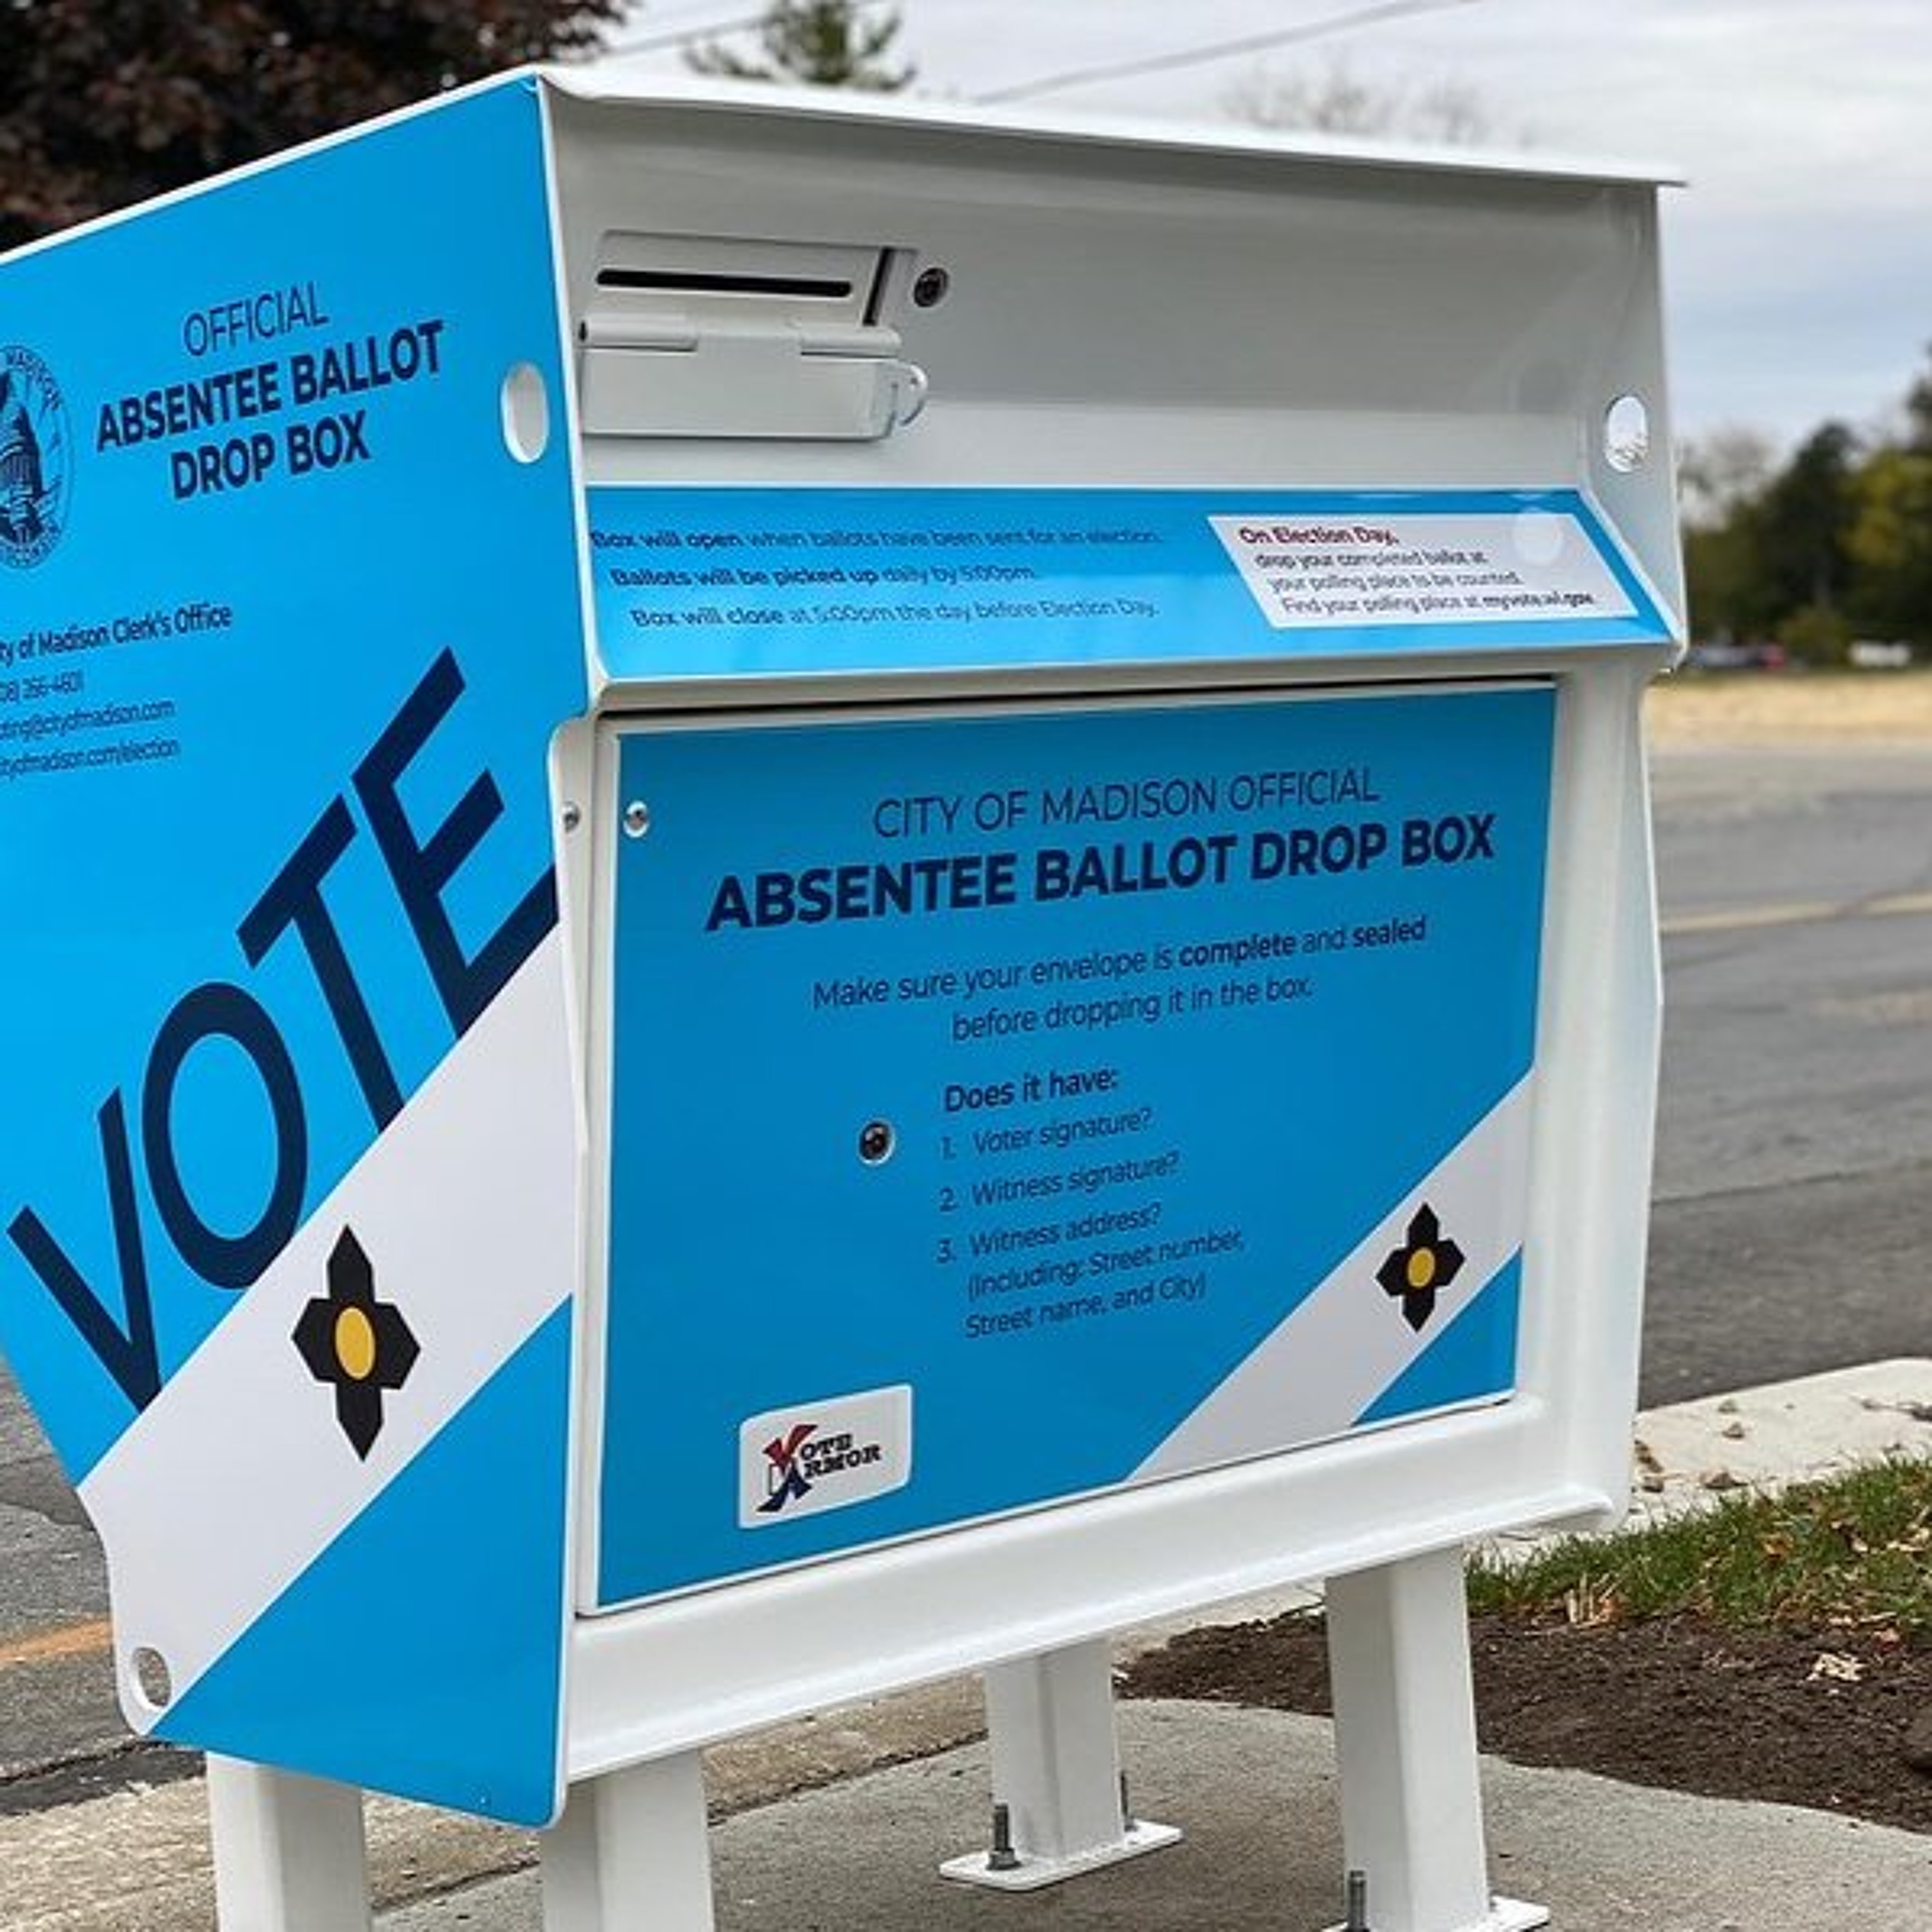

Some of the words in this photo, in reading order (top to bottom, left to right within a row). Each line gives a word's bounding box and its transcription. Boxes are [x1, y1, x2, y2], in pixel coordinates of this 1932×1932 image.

[184, 283, 328, 356] OFFICIAL
[97, 364, 281, 451] ABSENTEE
[292, 321, 443, 404] BALLOT
[171, 433, 275, 498] DROP
[288, 411, 372, 474] BOX
[590, 530, 634, 548] Box
[639, 530, 681, 547] will
[687, 533, 742, 550] open
[931, 530, 983, 545] been
[1239, 527, 1273, 544] On
[1273, 526, 1353, 544] Election
[1296, 554, 1333, 569] your
[1336, 551, 1421, 567] completed
[611, 568, 692, 586] Ballots
[694, 568, 734, 586] will
[736, 568, 768, 585] be
[773, 567, 844, 587] picked
[848, 569, 878, 587] up
[882, 565, 928, 585] daily
[931, 565, 958, 585] by
[1267, 577, 1307, 593] your
[1311, 574, 1366, 591] polling
[1367, 574, 1411, 589] place
[1282, 596, 1321, 612] Find
[1321, 599, 1359, 615] your
[1362, 596, 1419, 613] polling
[1420, 595, 1462, 611] place
[19, 633, 33, 659] of
[39, 624, 110, 656] Madison
[113, 611, 172, 643] Clerk's
[175, 602, 232, 634] Office
[630, 609, 677, 627] Box
[682, 607, 723, 625] will
[726, 607, 784, 625] close
[790, 609, 812, 624] at
[896, 605, 932, 621] the
[936, 603, 971, 623] day
[974, 601, 1036, 619] before
[1039, 600, 1119, 617] Election
[873, 797, 961, 837] CITY
[975, 791, 1028, 831] OF
[1041, 779, 1215, 825] MADISON
[1229, 768, 1379, 811] OFFICIAL
[705, 853, 1017, 931] ABSENTEE
[1036, 833, 1237, 901] BALLOT
[1251, 822, 1387, 880] DROP
[1402, 813, 1496, 867] BOX
[813, 978, 890, 1010] Make
[898, 971, 956, 1000] sure
[963, 964, 1024, 999] your
[1031, 950, 1146, 985] envelope
[1155, 943, 1171, 969] is
[1179, 931, 1296, 969] complete
[1303, 925, 1345, 954] and
[1352, 916, 1426, 947] sealed
[6, 647, 559, 1413] VOTE
[952, 1007, 1039, 1042] before
[1046, 991, 1160, 1031] dropping
[1169, 987, 1184, 1014] it
[1191, 985, 1212, 1010] in
[1221, 978, 1258, 1006] the
[1266, 974, 1312, 1002] box.
[945, 1083, 1015, 1113] Does
[1023, 1073, 1041, 1103] it
[1049, 1067, 1119, 1099] have:
[942, 1137, 956, 1159] 1.
[973, 1128, 1032, 1155] Voter
[1040, 1107, 1151, 1148] signature?
[939, 1188, 958, 1212] 2.
[972, 1175, 1063, 1206] Witness
[1069, 1150, 1180, 1193] signature?
[936, 1239, 956, 1264] 3.
[969, 1225, 1060, 1256] Witness
[1066, 1202, 1160, 1240] address?
[1090, 1244, 1154, 1274] Street
[1159, 1228, 1244, 1262] number,
[966, 1309, 1032, 1338] Street
[1040, 1293, 1106, 1325] name,
[1114, 1280, 1154, 1309] and
[1160, 1271, 1206, 1300] City)
[756, 1444, 882, 1511] ARMOR
[762, 1424, 853, 1477] VOTE
